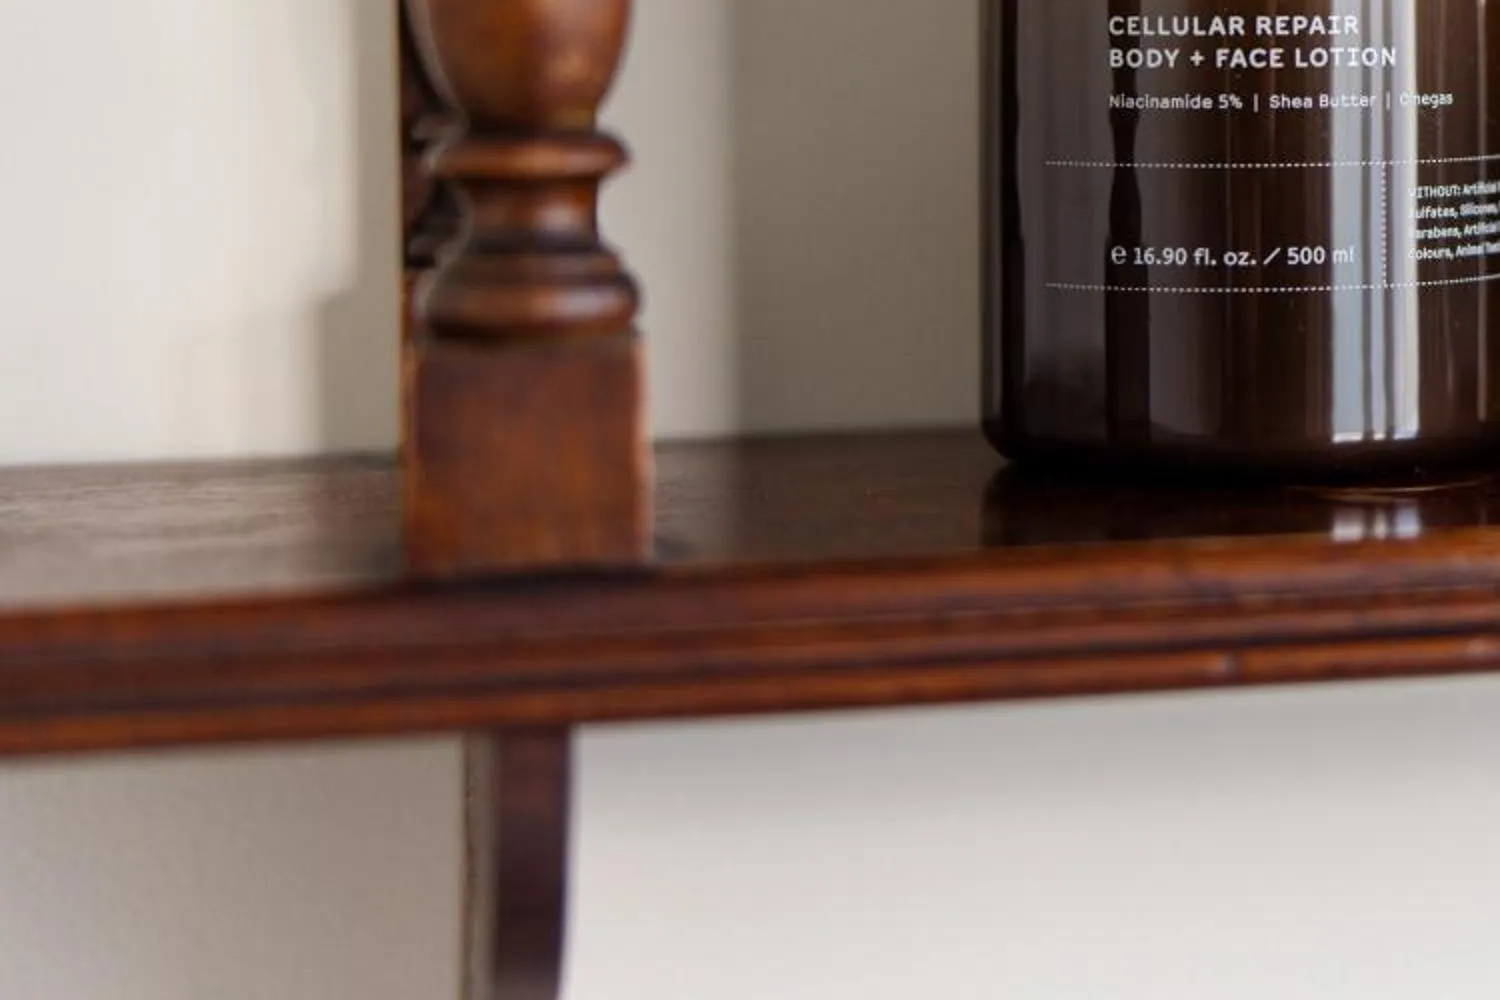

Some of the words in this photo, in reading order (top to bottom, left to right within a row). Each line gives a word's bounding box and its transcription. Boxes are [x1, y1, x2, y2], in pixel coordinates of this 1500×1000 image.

[1108, 15, 1245, 36] CELLULAR
[1255, 15, 1360, 36] REPAIR
[1109, 48, 1180, 68] BODY
[1190, 52, 1204, 67] +
[1216, 48, 1285, 68] FACE
[1294, 46, 1397, 68] LOTION
[1109, 94, 1213, 109] Niacinamide
[1219, 93, 1243, 109] 5%
[1269, 93, 1313, 109] Shea
[1319, 93, 1376, 109] Butter
[1408, 225, 1461, 240] arabens,
[1133, 248, 1187, 265] 16.90
[1193, 248, 1217, 265] fl.
[1223, 250, 1257, 266] oz.
[1287, 246, 1325, 265] 500
[1332, 246, 1355, 264] ml
